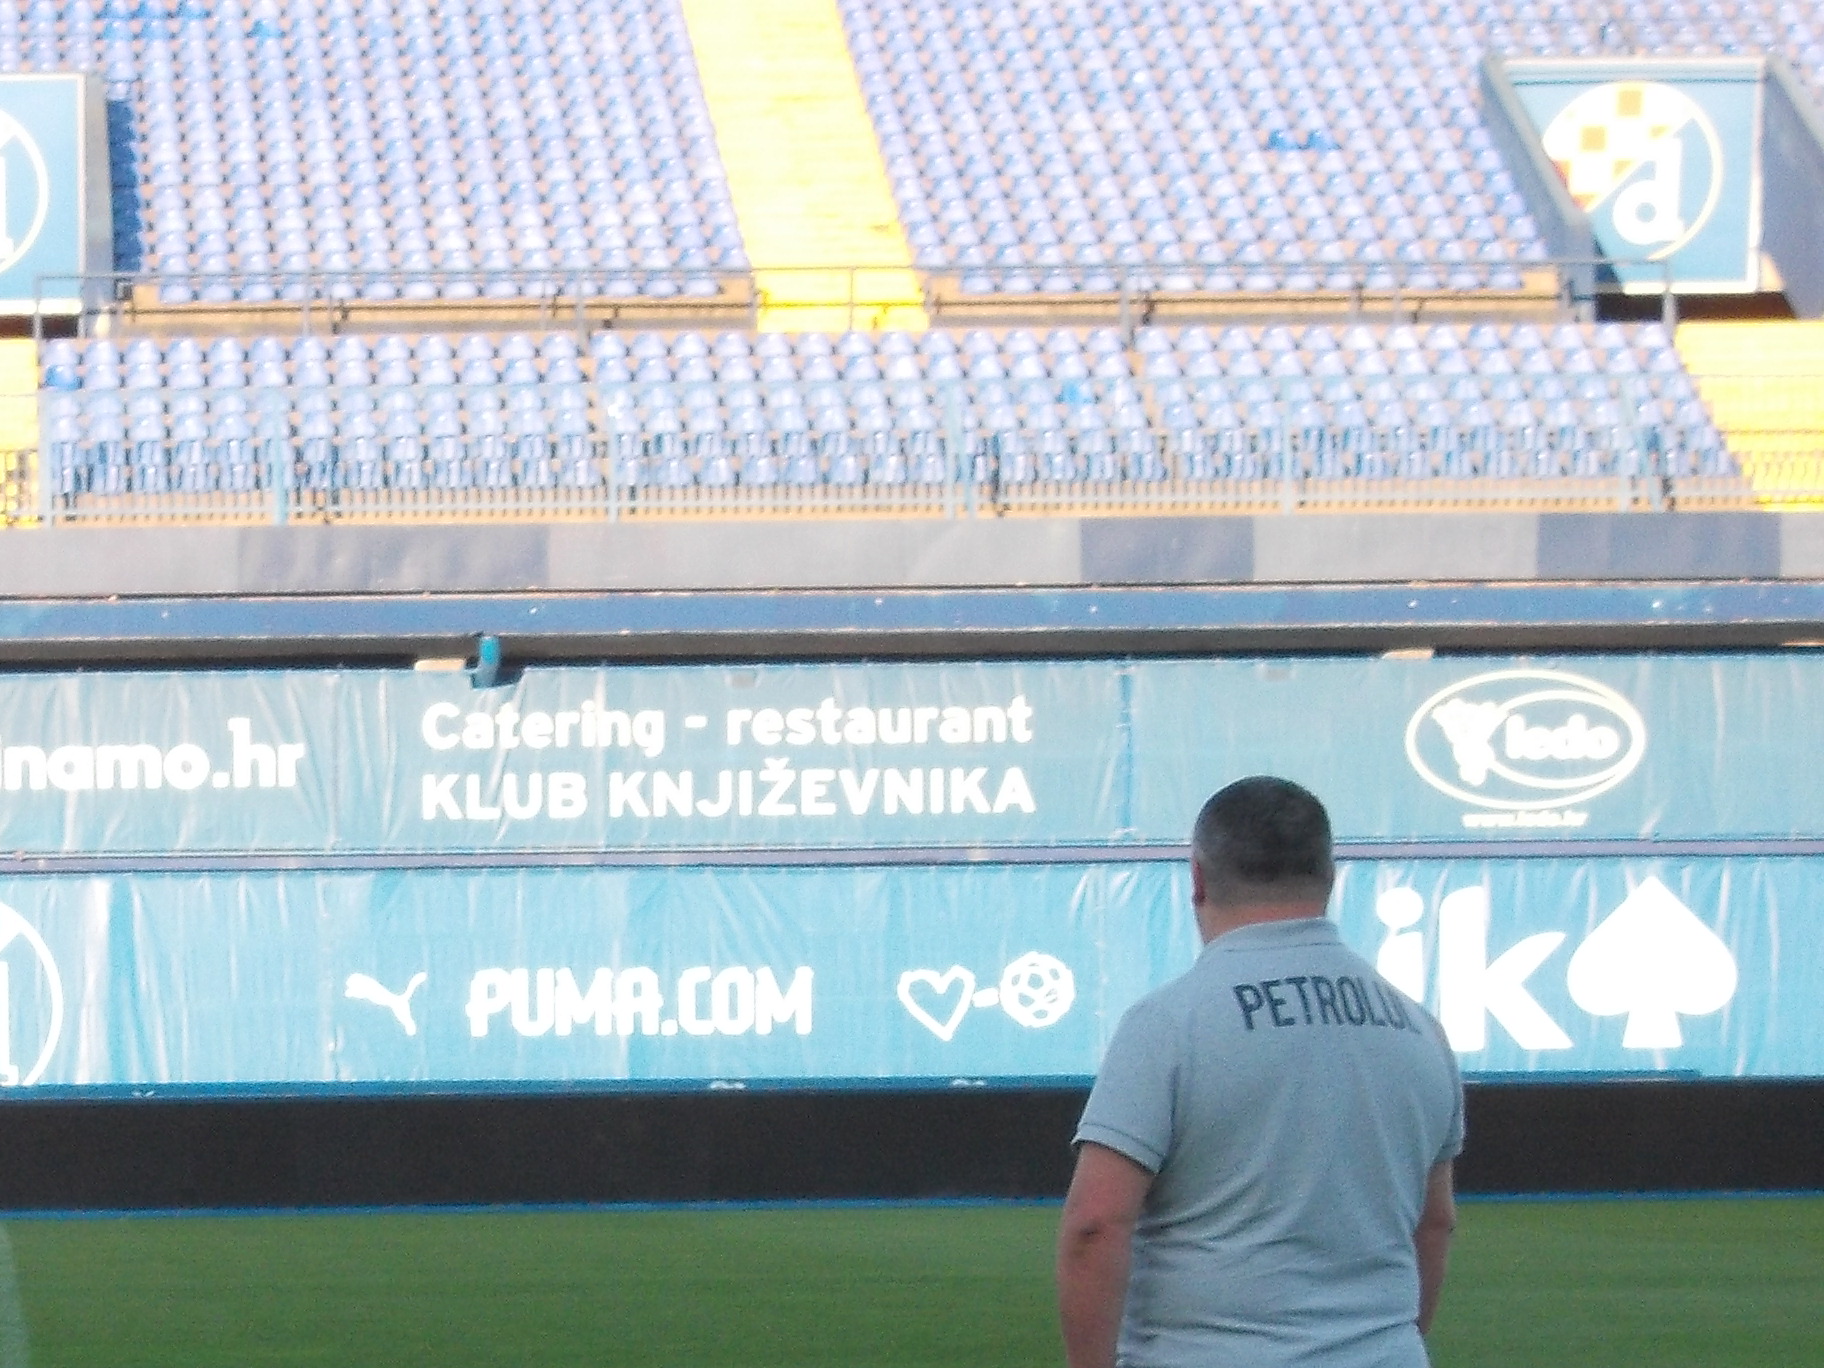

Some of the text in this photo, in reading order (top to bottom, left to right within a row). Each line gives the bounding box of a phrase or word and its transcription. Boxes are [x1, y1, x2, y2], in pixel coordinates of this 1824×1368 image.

[422, 701, 666, 758] Catering
[726, 695, 1034, 746] restaurant
[421, 756, 1037, 821] KLUB KNJIŽEVNIKA
[464, 965, 815, 1038] PUMA.COM
[1375, 885, 1575, 1053] ik
